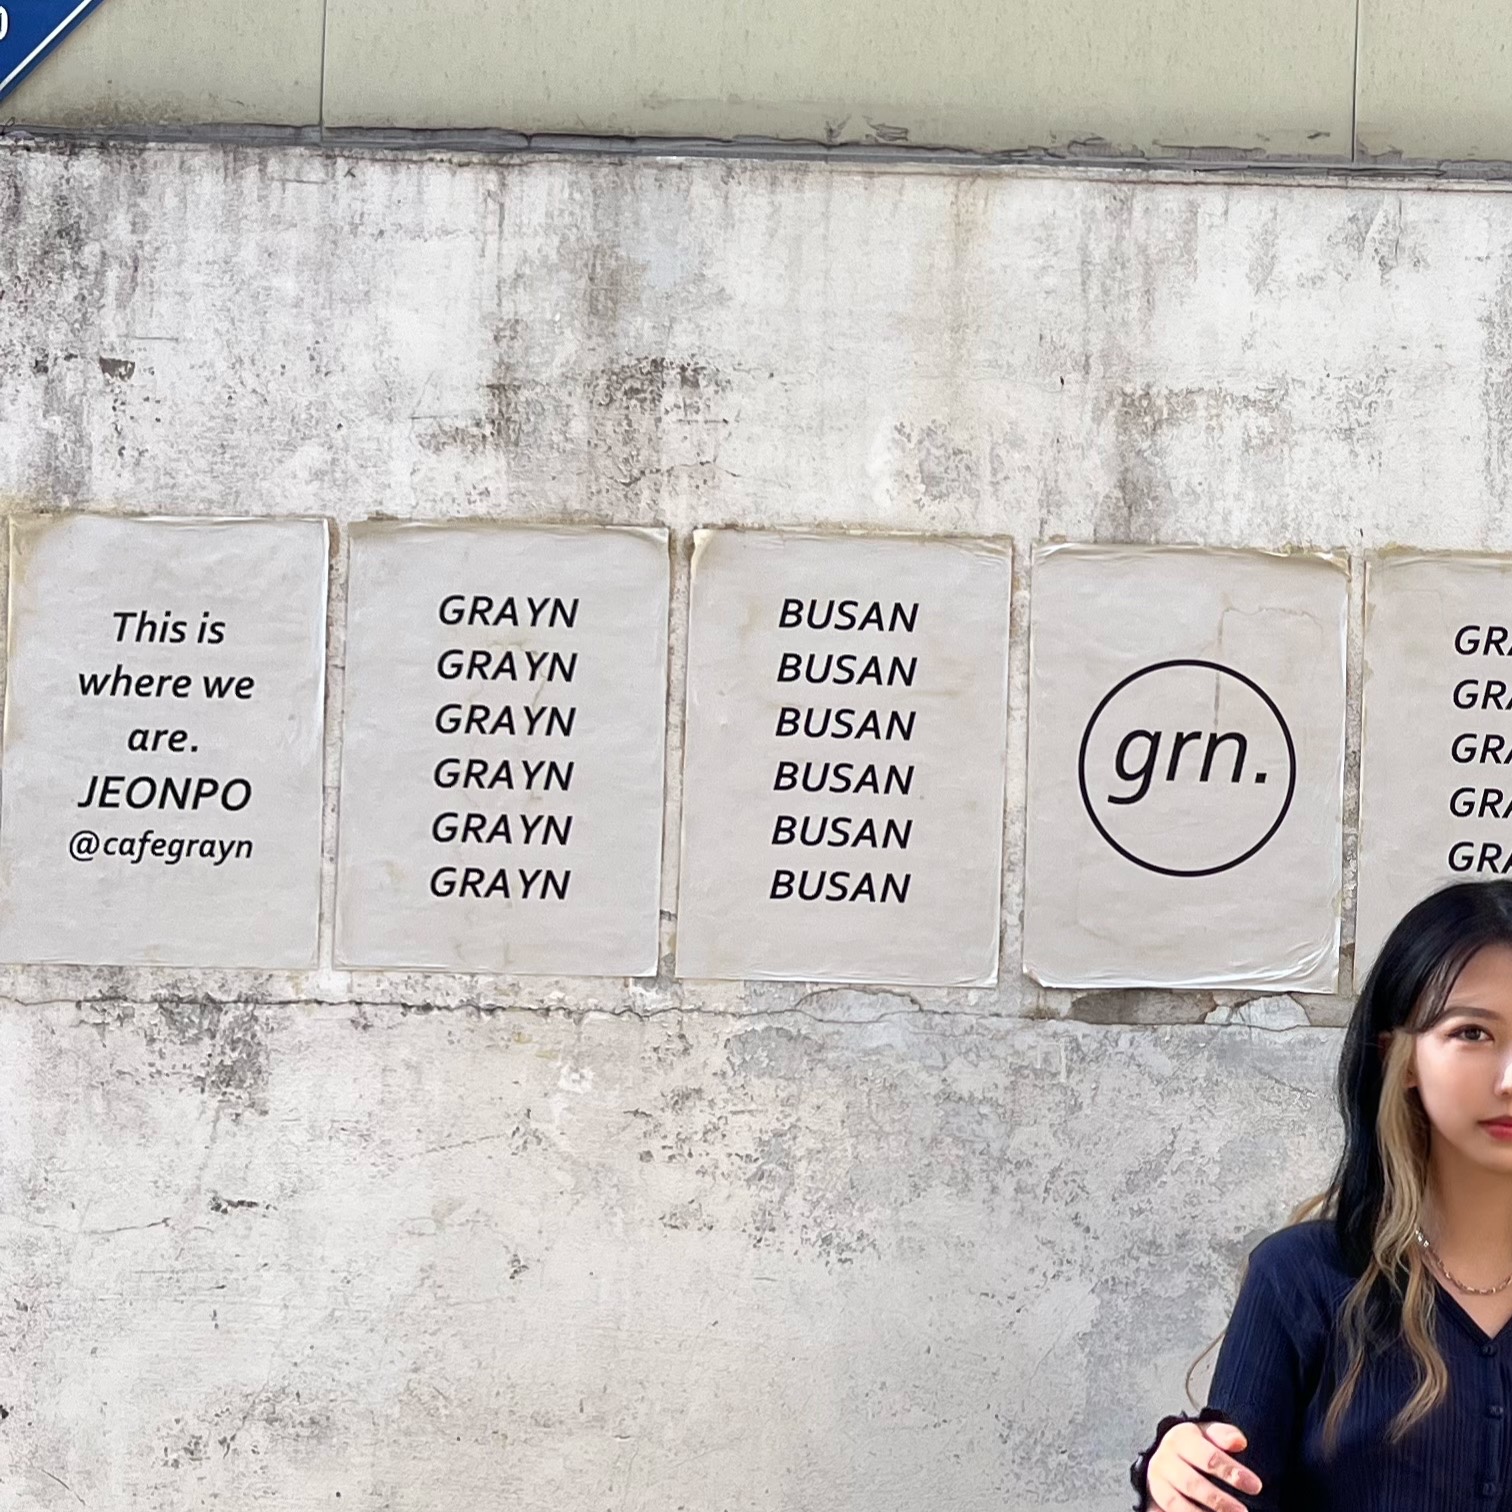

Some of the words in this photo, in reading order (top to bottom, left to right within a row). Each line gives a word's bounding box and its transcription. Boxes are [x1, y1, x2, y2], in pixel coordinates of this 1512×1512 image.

[113, 610, 188, 644] This
[197, 611, 226, 644] is
[439, 594, 579, 628] GRAYN
[778, 598, 919, 633] BUSAN
[78, 664, 192, 698] where
[203, 676, 255, 700] we
[437, 649, 578, 683] GRAYN
[776, 652, 918, 687] BUSAN
[435, 703, 576, 737] GRAYN
[775, 706, 917, 741] BUSAN
[127, 728, 199, 753] are.
[434, 758, 575, 791] GRAYN
[773, 761, 915, 795] BUSAN
[1107, 729, 1267, 805] grn.
[77, 775, 252, 812] JEONPO
[432, 812, 573, 846] GRAYN
[771, 815, 913, 849] BUSAN
[69, 829, 253, 866] @cafegrayn
[430, 866, 571, 900] GRAYN
[769, 869, 912, 904] BUSAN
